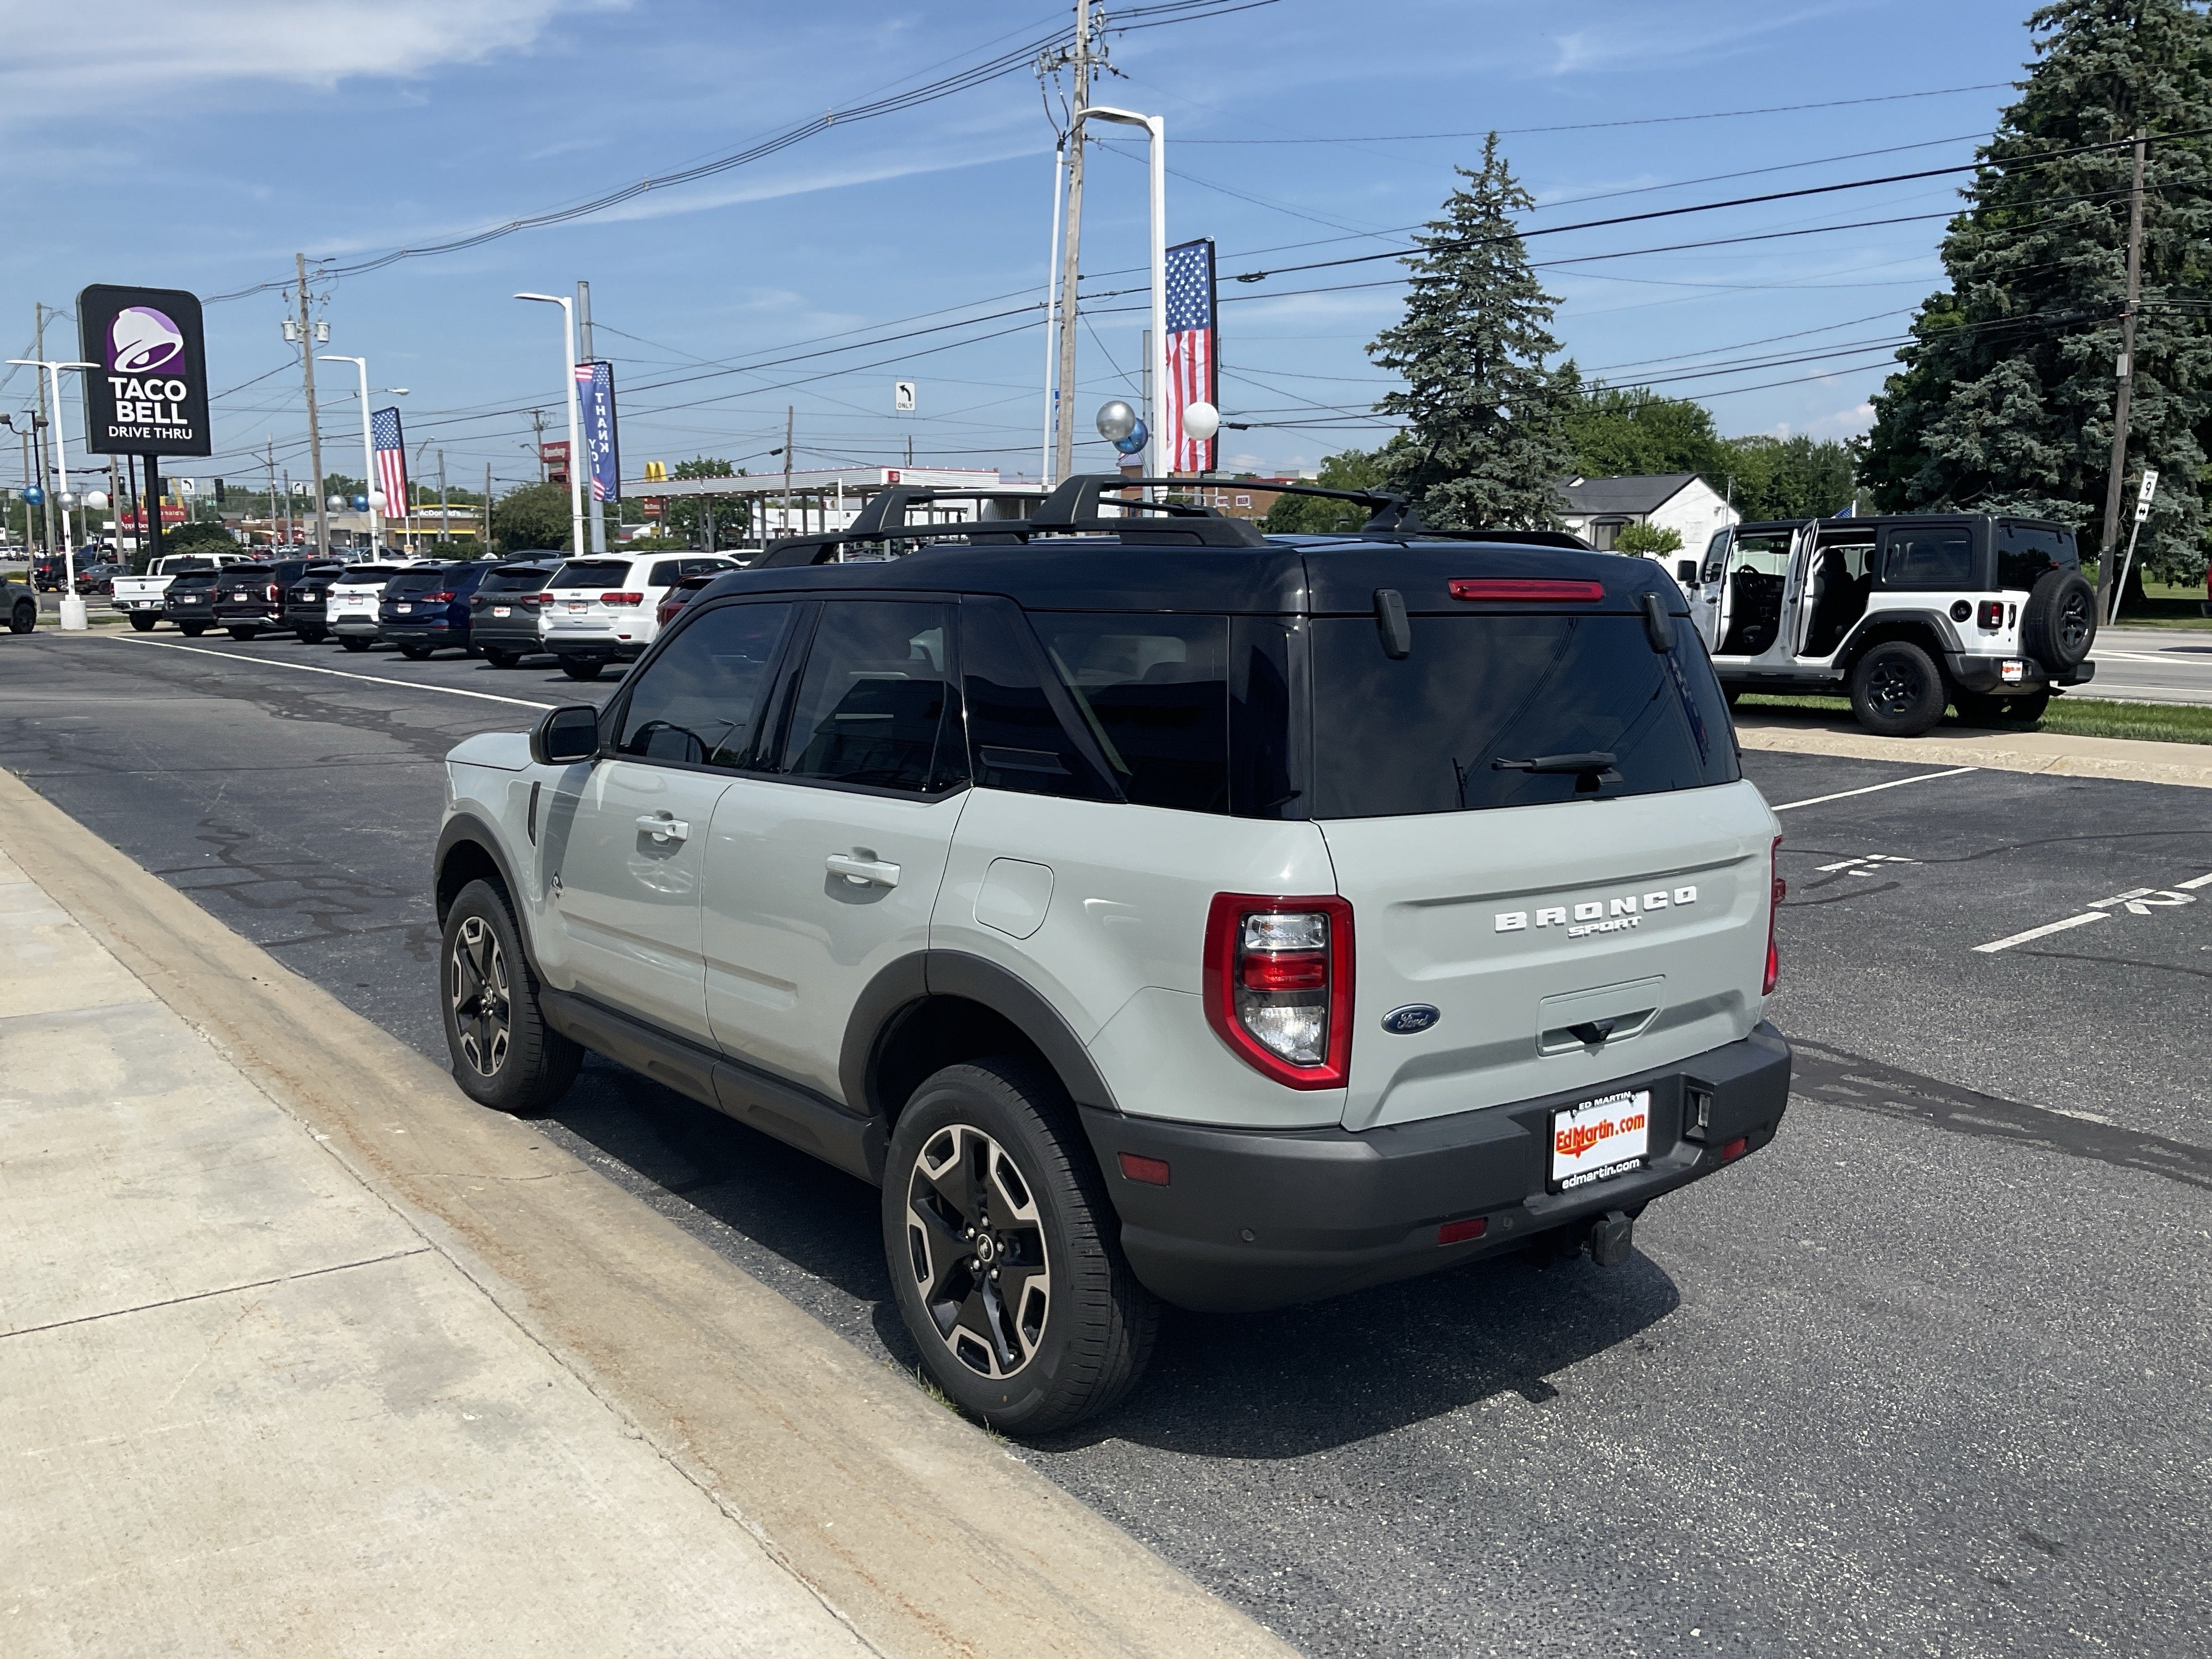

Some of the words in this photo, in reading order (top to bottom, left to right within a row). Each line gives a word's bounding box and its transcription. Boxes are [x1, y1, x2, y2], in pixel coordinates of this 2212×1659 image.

[108, 376, 187, 402] TACO
[116, 400, 188, 425] BELL
[108, 426, 151, 438] DRIVE
[153, 427, 193, 439] THRU
[2146, 481, 2152, 498] 9
[1494, 885, 1697, 933] BRONCO
[1567, 915, 1643, 939] SPORT
[1397, 1012, 1430, 1030] Ford
[1578, 1102, 1592, 1110] ED
[1594, 1091, 1631, 1107] MARTIN
[1555, 1113, 1645, 1153] EdMartin.com
[1562, 1158, 1640, 1189] edmartin.com
